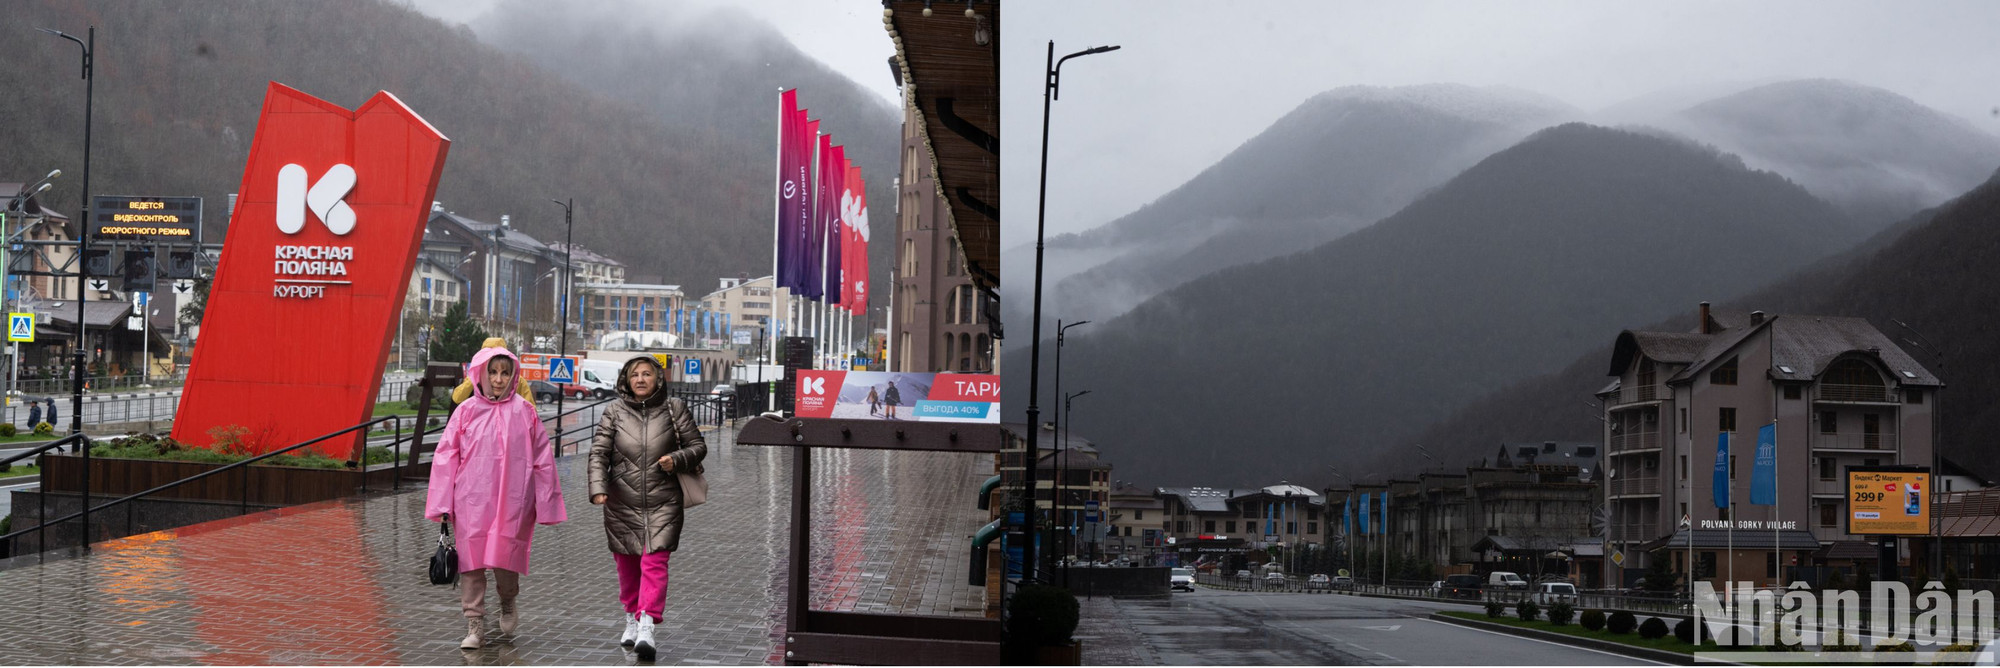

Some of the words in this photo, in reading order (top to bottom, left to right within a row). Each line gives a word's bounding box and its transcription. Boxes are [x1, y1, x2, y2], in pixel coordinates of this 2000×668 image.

[129, 202, 164, 210] ВЕДЕТСЯ
[114, 214, 179, 223] ВИДЕОКОНТРОЛЬ
[101, 226, 157, 235] СКОРОСТНОГО
[158, 228, 190, 236] РЕЖИМА
[275, 245, 354, 260] КРАСНАЯ
[274, 260, 347, 276] ПОЛЯНА
[273, 285, 326, 298] КУРОРТ
[923, 405, 959, 414] ВЫГОДА
[961, 406, 980, 415] 40%
[1854, 492, 1875, 502] 299
[1701, 520, 1734, 528] POLYANA
[1738, 520, 1763, 529] GORKY
[1766, 521, 1796, 529] VILLAGE
